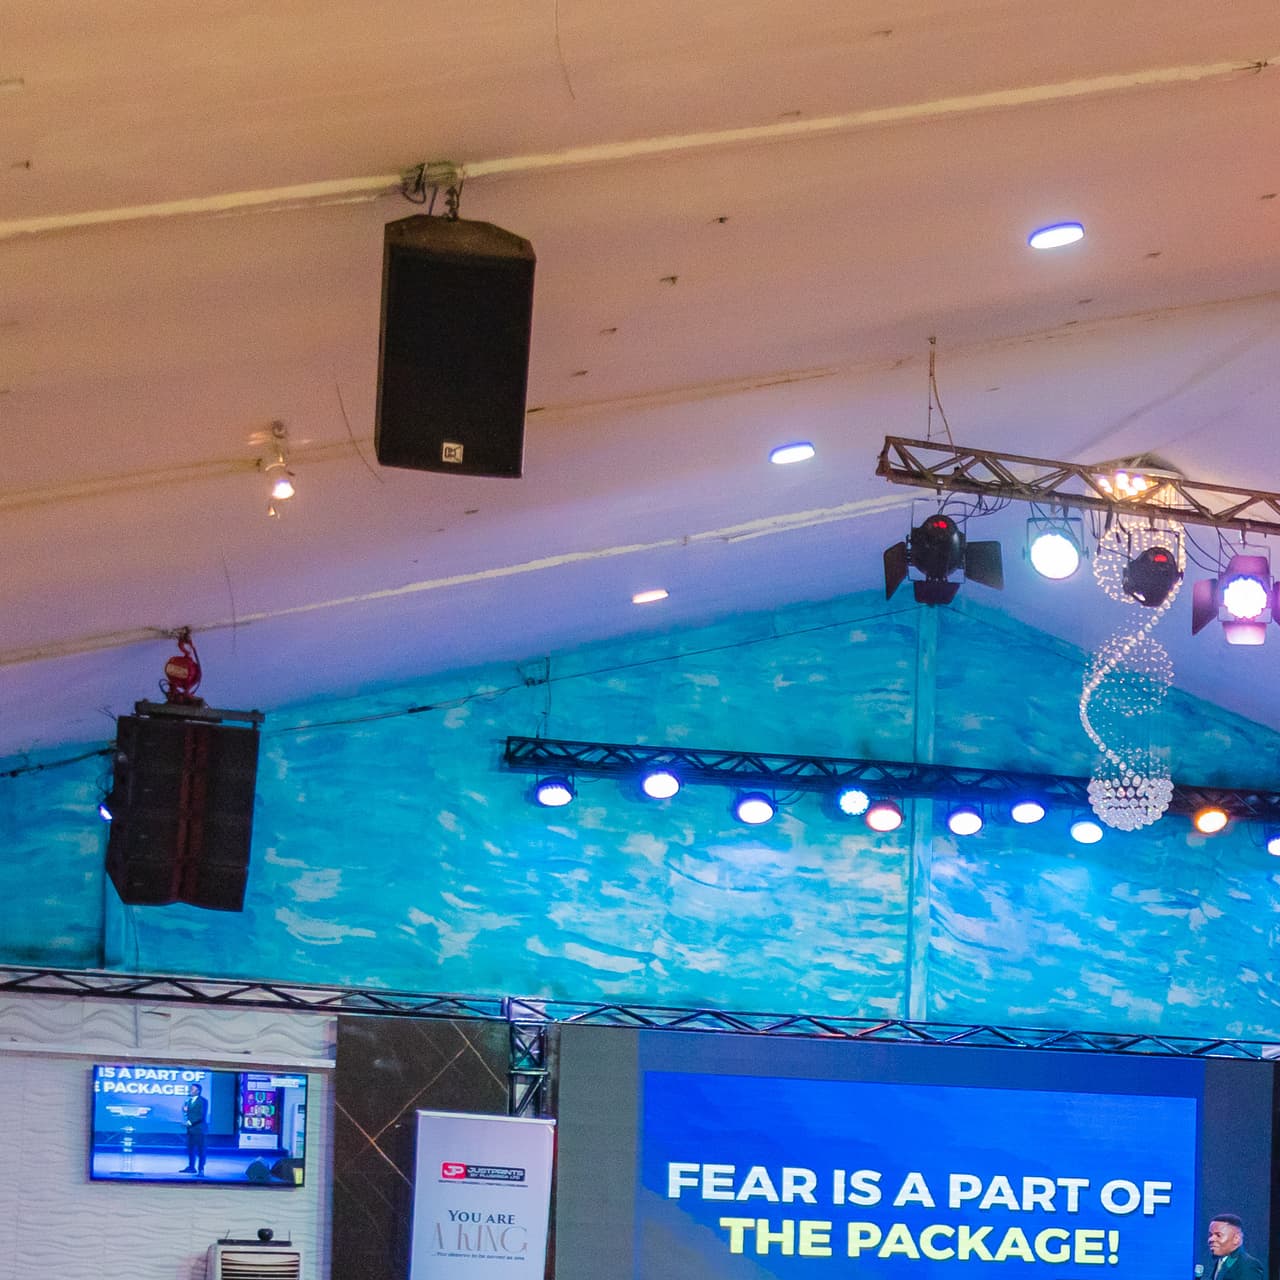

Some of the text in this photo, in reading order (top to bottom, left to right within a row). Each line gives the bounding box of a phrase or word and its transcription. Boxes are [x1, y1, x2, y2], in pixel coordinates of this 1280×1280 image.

[99, 1067, 206, 1082] IS A PART OF
[104, 1082, 190, 1097] PACKAGE!
[668, 1162, 1175, 1215] FEAR IS A PART OF
[448, 1209, 516, 1225] YOU ARE
[719, 1217, 1122, 1265] THE PACKAGE!
